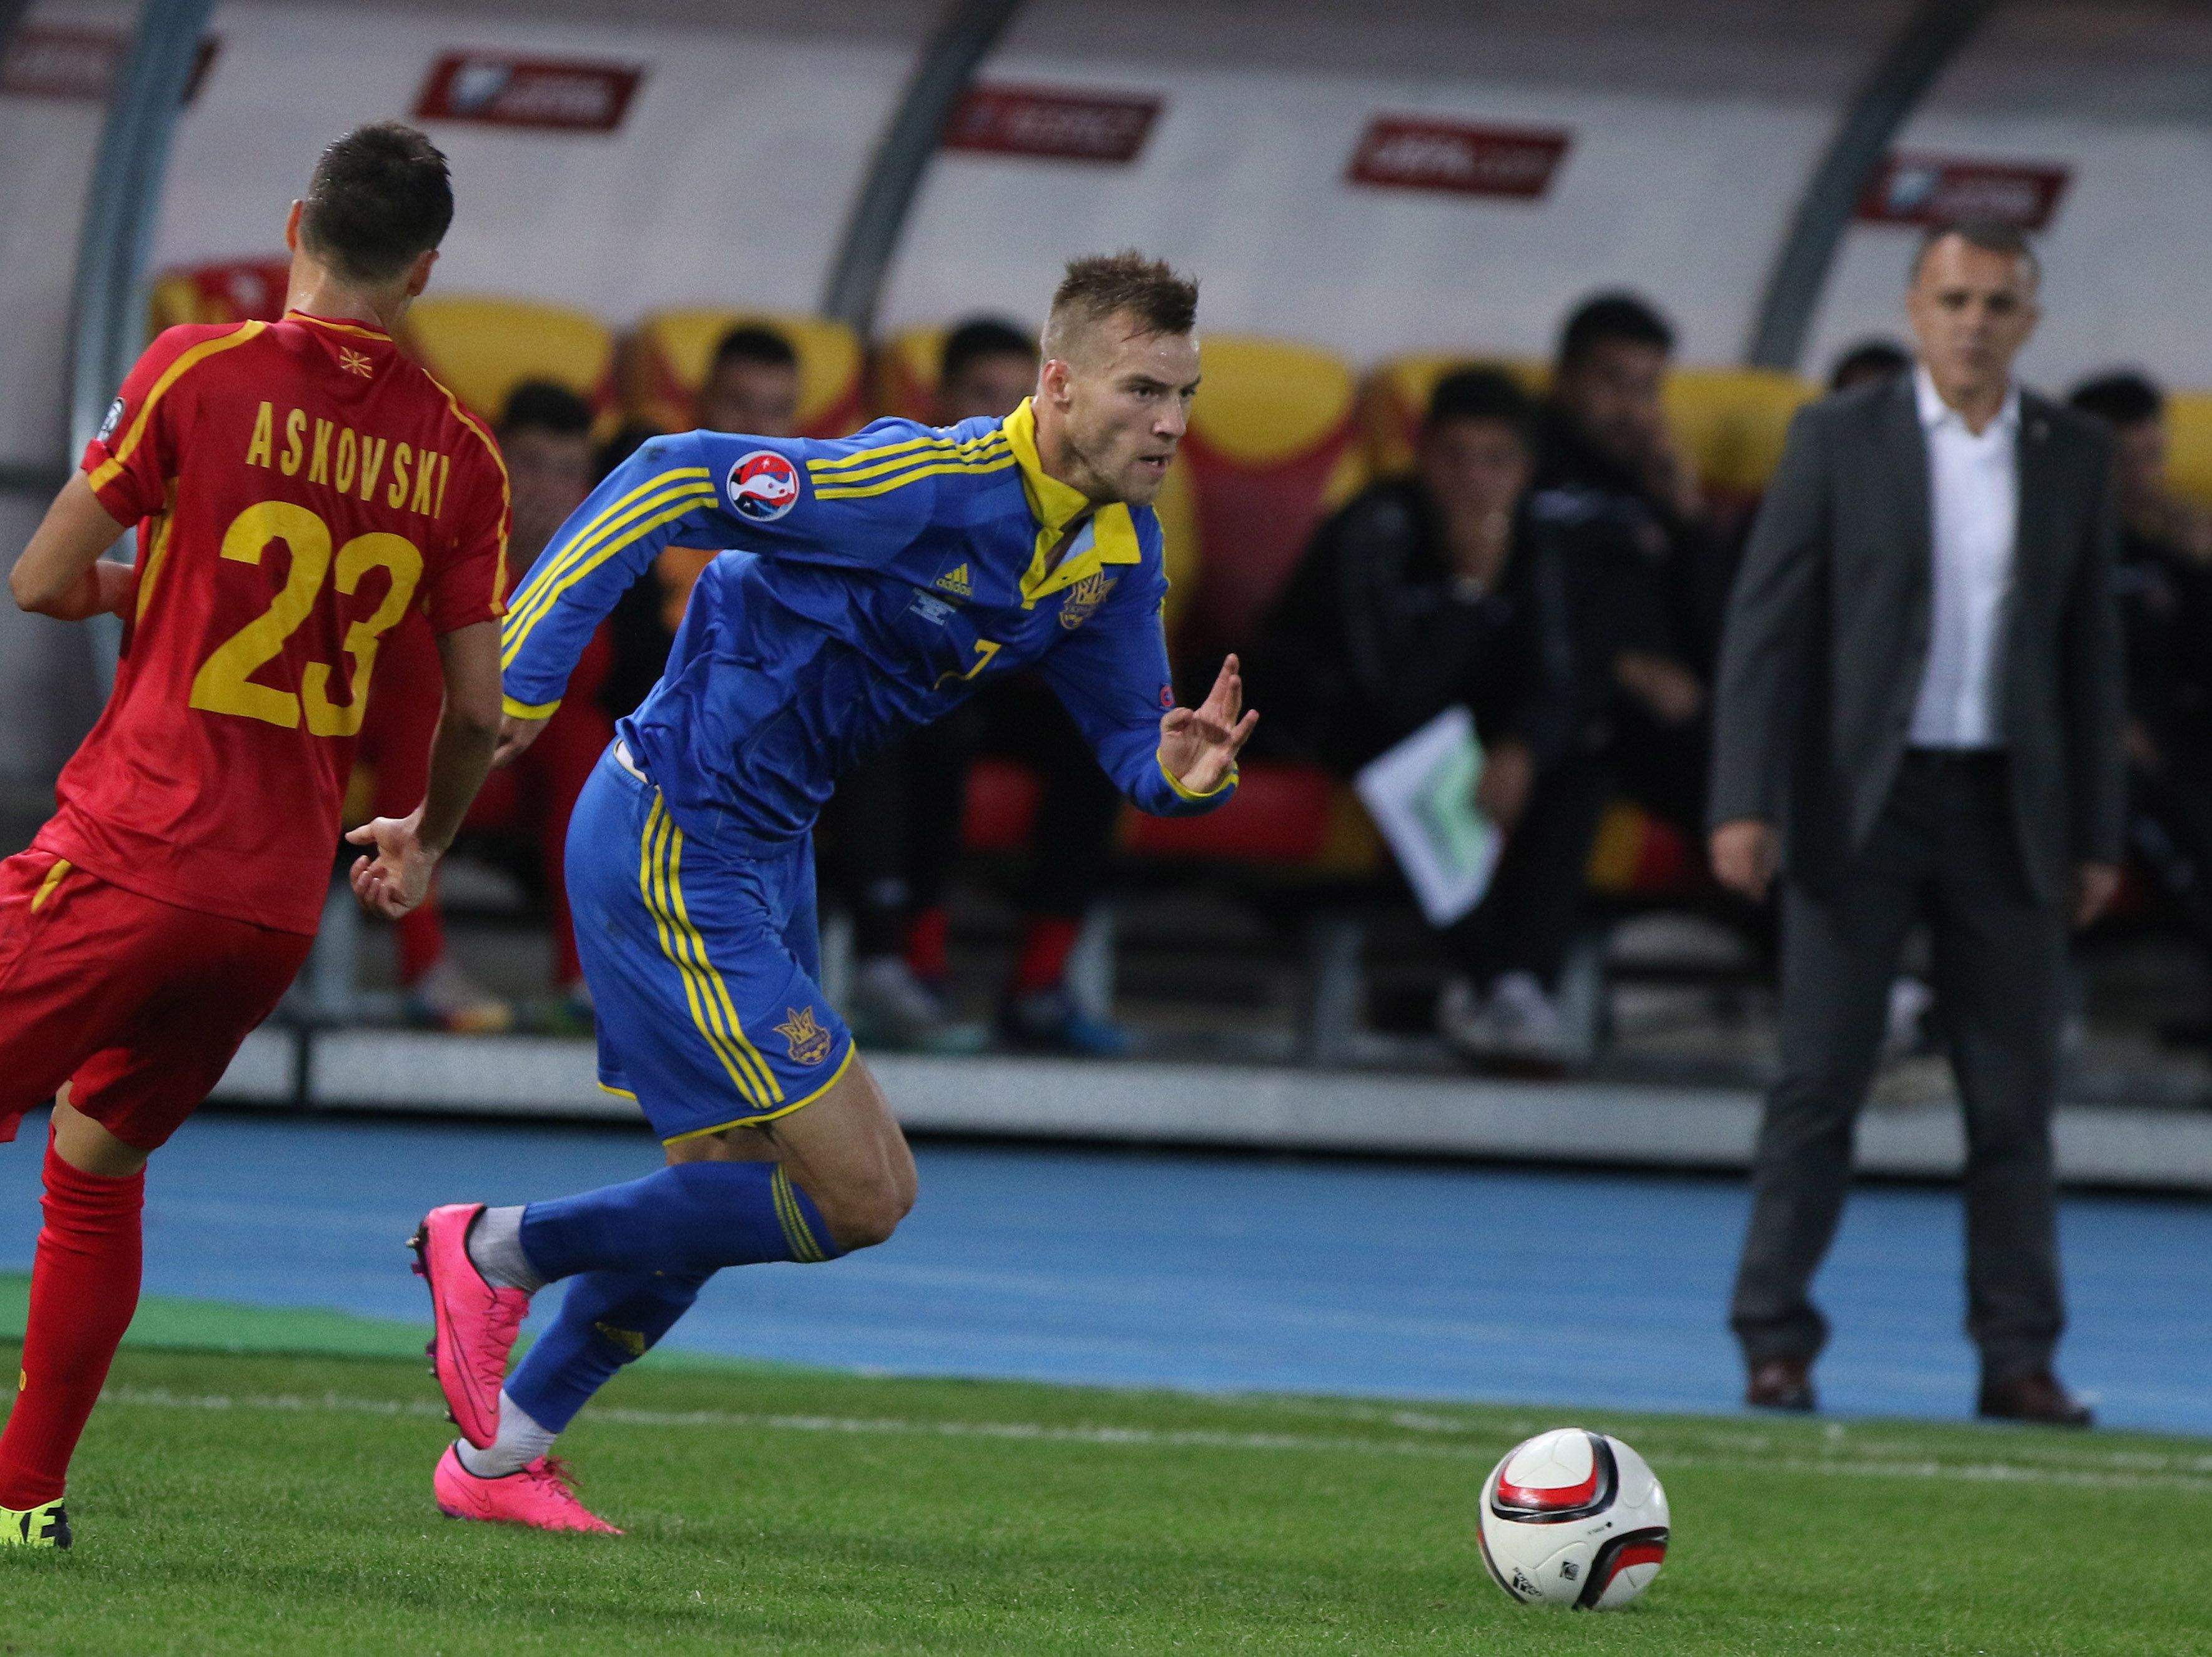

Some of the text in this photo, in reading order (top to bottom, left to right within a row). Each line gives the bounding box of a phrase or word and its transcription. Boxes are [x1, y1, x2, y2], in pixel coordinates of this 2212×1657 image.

[245, 401, 450, 519] ASKOVSKI
[189, 500, 424, 737] 23
[960, 639, 1001, 681] 7
